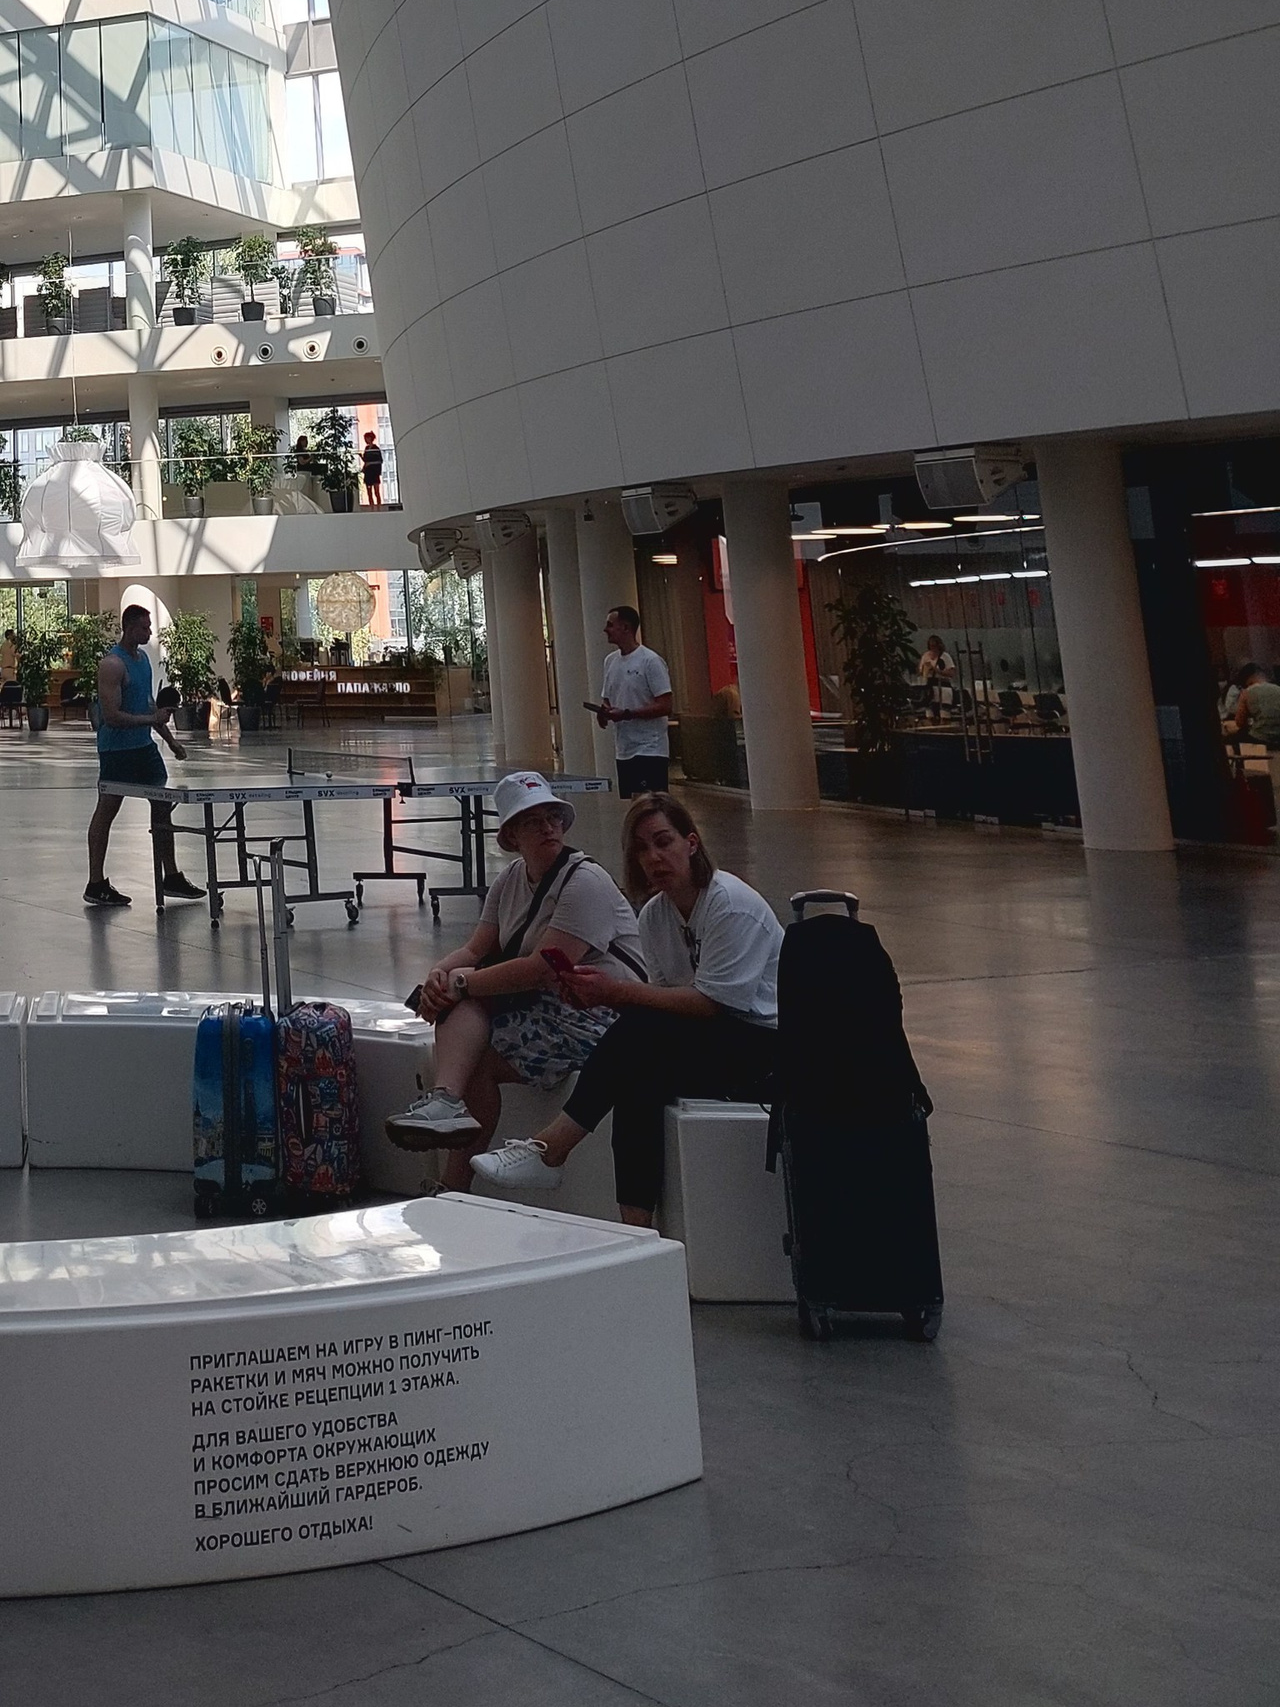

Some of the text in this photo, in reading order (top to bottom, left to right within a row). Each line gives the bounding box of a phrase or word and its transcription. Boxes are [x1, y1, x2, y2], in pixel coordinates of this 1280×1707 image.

[337, 682, 370, 693] ПАПА
[317, 789, 335, 797] SVX
[449, 786, 466, 794] SVX
[190, 1345, 310, 1371] ПРИГЛАШАЕМ
[316, 1342, 338, 1358] НА
[343, 1336, 383, 1355] ИГРУ
[389, 1335, 399, 1349] В
[191, 1345, 479, 1395] РАКЕТКИ И МЯЧ МОЖНО ПОЛУЧИТЬ
[192, 1371, 459, 1417] НА СТОЙКЕ РЕЦЕПЦИИ 1 ЭТАЖА.
[192, 1411, 398, 1453] ДЛЯ ВАШЕГО УДОБСТВА
[194, 1428, 436, 1473] И КОМФОРТА ОКРУЖАЮЩИХ
[194, 1441, 489, 1496] ПРОСИМ СДАТЬ ВЕРХНЮЮ ОДЕЖДУ
[194, 1476, 423, 1520] В БЛИЖАЙШИЙ ГАРДЕРОБ.
[195, 1515, 373, 1552] ХОРОШЕГО ОТДЫХА!
